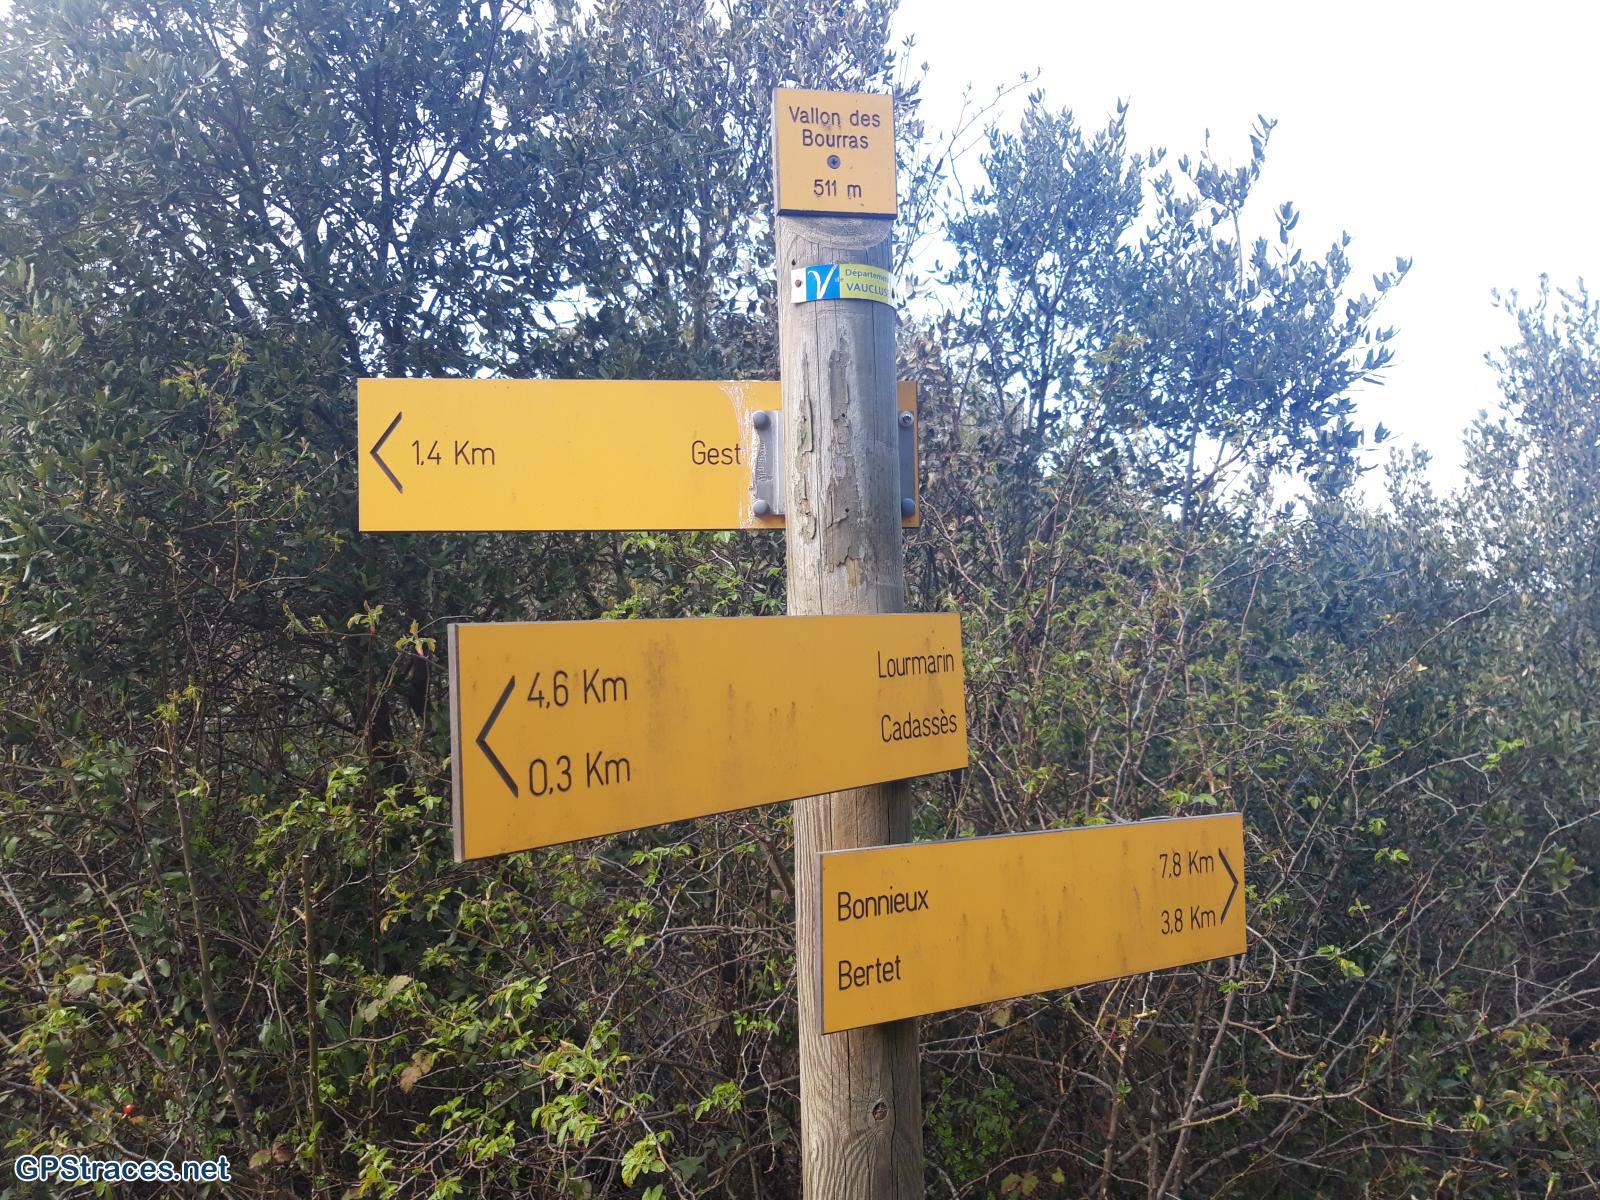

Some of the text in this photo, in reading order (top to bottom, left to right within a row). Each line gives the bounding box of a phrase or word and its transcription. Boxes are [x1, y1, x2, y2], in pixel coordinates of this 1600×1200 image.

[788, 105, 881, 127] Vallon des
[802, 128, 869, 149] Bourras
[813, 179, 862, 198] 511 m
[411, 440, 496, 466] 1,4 Km
[691, 440, 741, 465] Gest
[877, 646, 955, 679] Lourmarin
[527, 668, 628, 709] 4,6 Km
[881, 708, 958, 743] Cadassès
[529, 750, 631, 796] 0,3 Km
[1159, 849, 1214, 879] 7,8 Km
[837, 885, 929, 922] Bonnieux
[1161, 904, 1216, 935] 3,8 Km
[838, 954, 901, 991] Bertet
